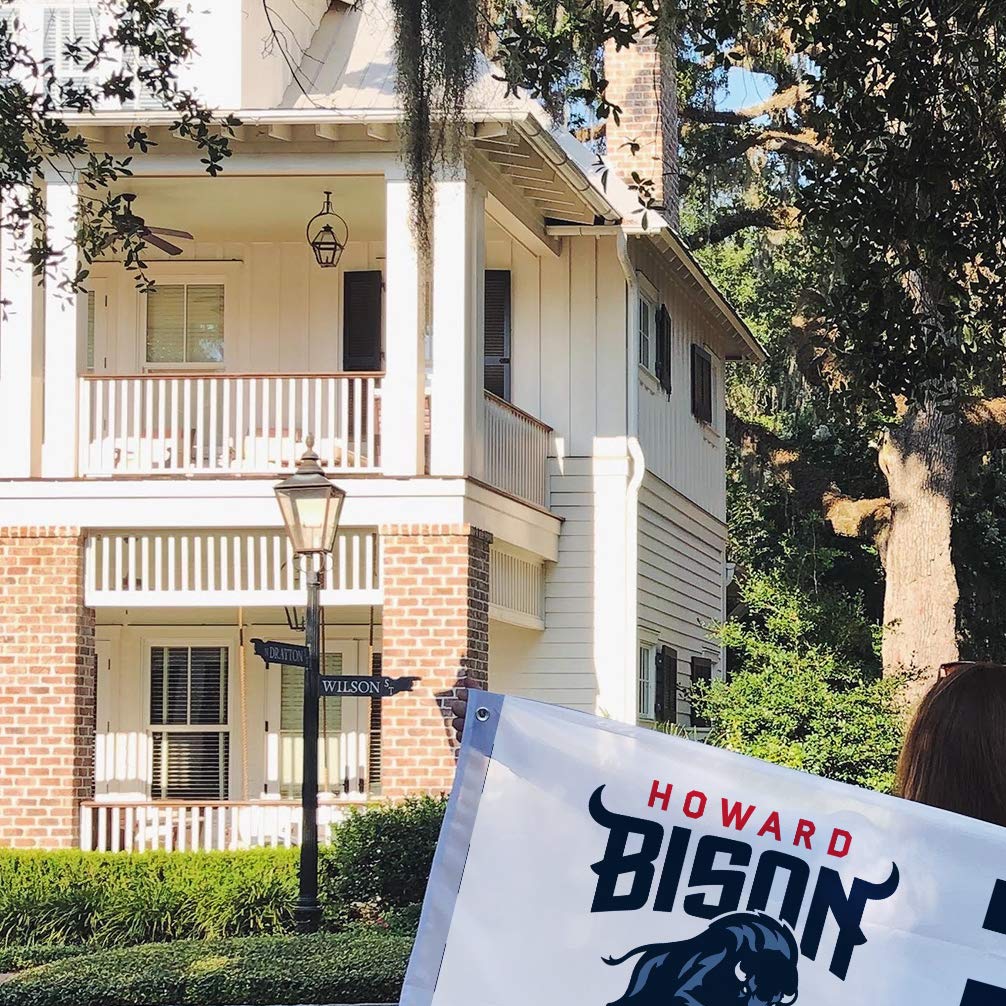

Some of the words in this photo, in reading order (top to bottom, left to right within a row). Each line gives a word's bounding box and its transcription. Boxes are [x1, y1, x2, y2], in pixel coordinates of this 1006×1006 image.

[322, 680, 380, 694] WILSON
[384, 678, 394, 696] ST
[647, 779, 853, 859] HOWARD
[588, 783, 900, 982] BISON
